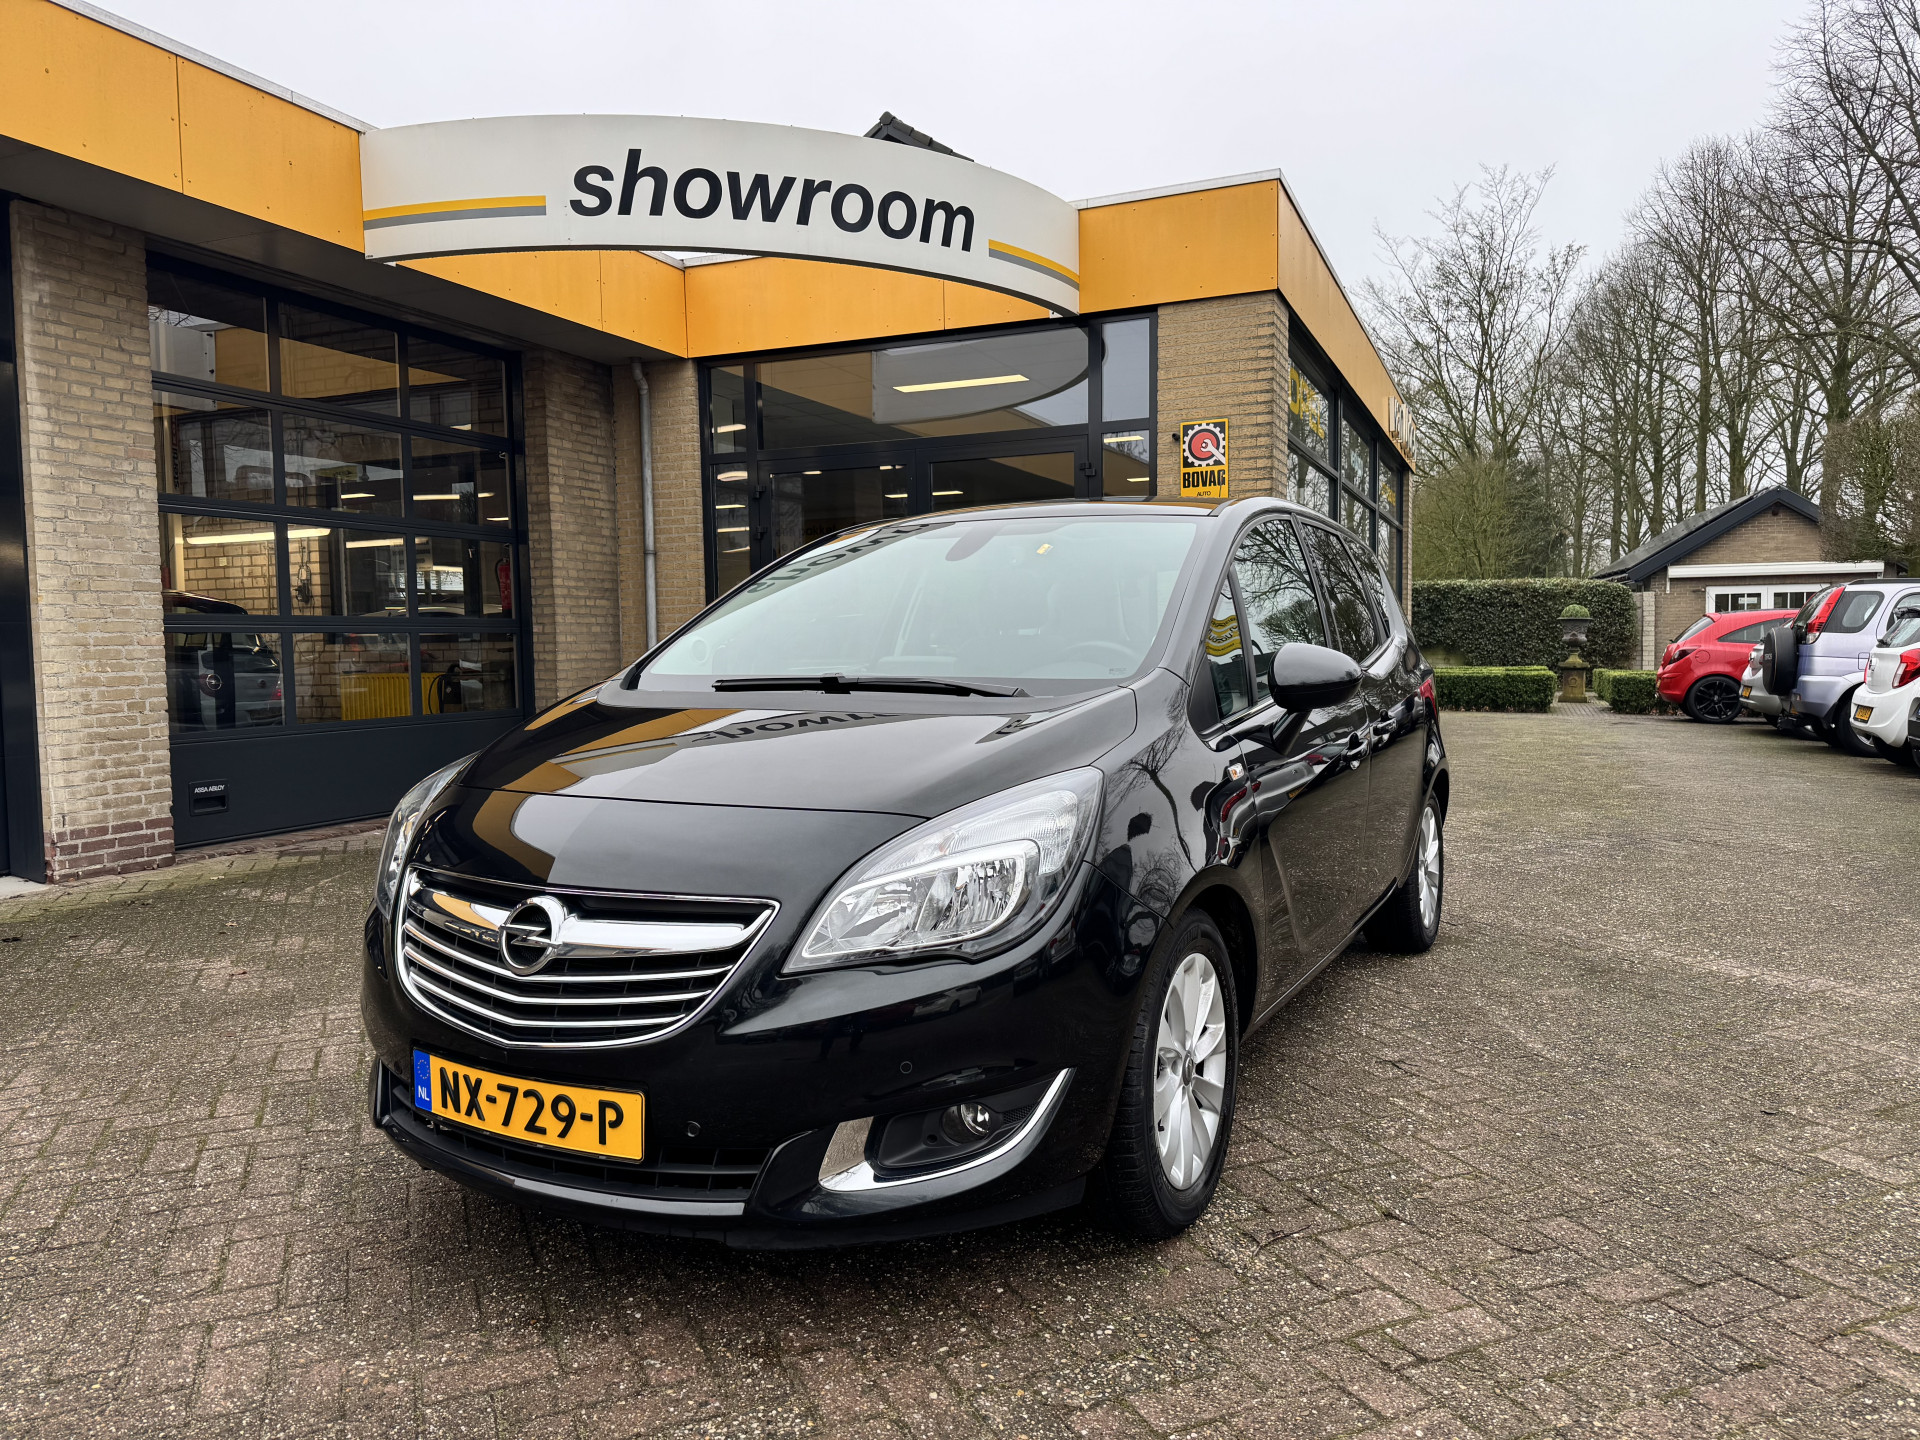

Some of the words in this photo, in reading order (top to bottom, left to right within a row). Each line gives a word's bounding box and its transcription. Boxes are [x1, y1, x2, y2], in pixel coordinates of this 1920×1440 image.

[569, 148, 975, 253] showroom
[1182, 469, 1226, 489] BOVAG
[418, 1085, 430, 1101] NL
[439, 1066, 624, 1146] NX-729-P
